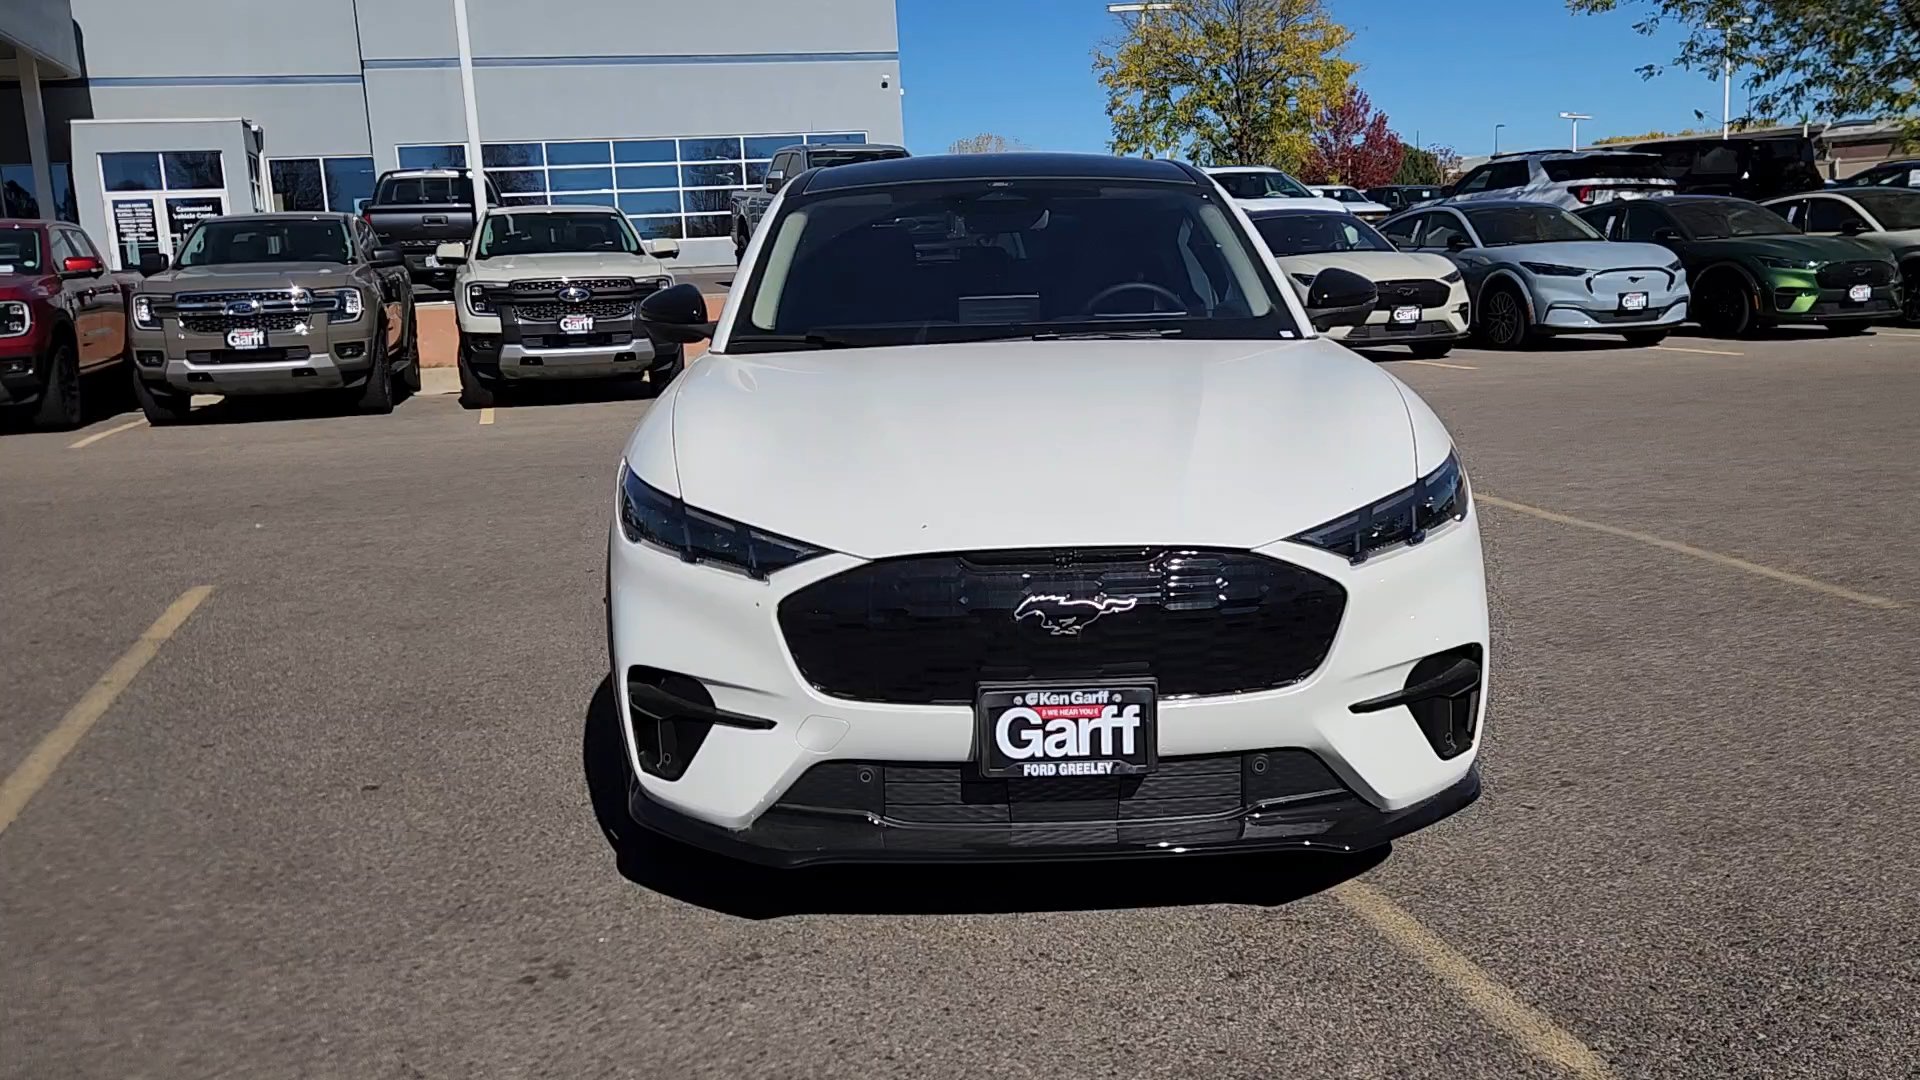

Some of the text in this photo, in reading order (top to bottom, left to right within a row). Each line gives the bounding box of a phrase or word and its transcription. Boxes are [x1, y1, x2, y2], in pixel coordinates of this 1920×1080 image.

[560, 317, 594, 331] Garff
[227, 330, 265, 346] Garff
[1039, 691, 1110, 705] Ken Garff
[1060, 708, 1079, 716] HEAR
[1079, 708, 1094, 716] YOU
[995, 705, 1141, 760] Garff
[1023, 762, 1114, 776] FORD GREELEY
